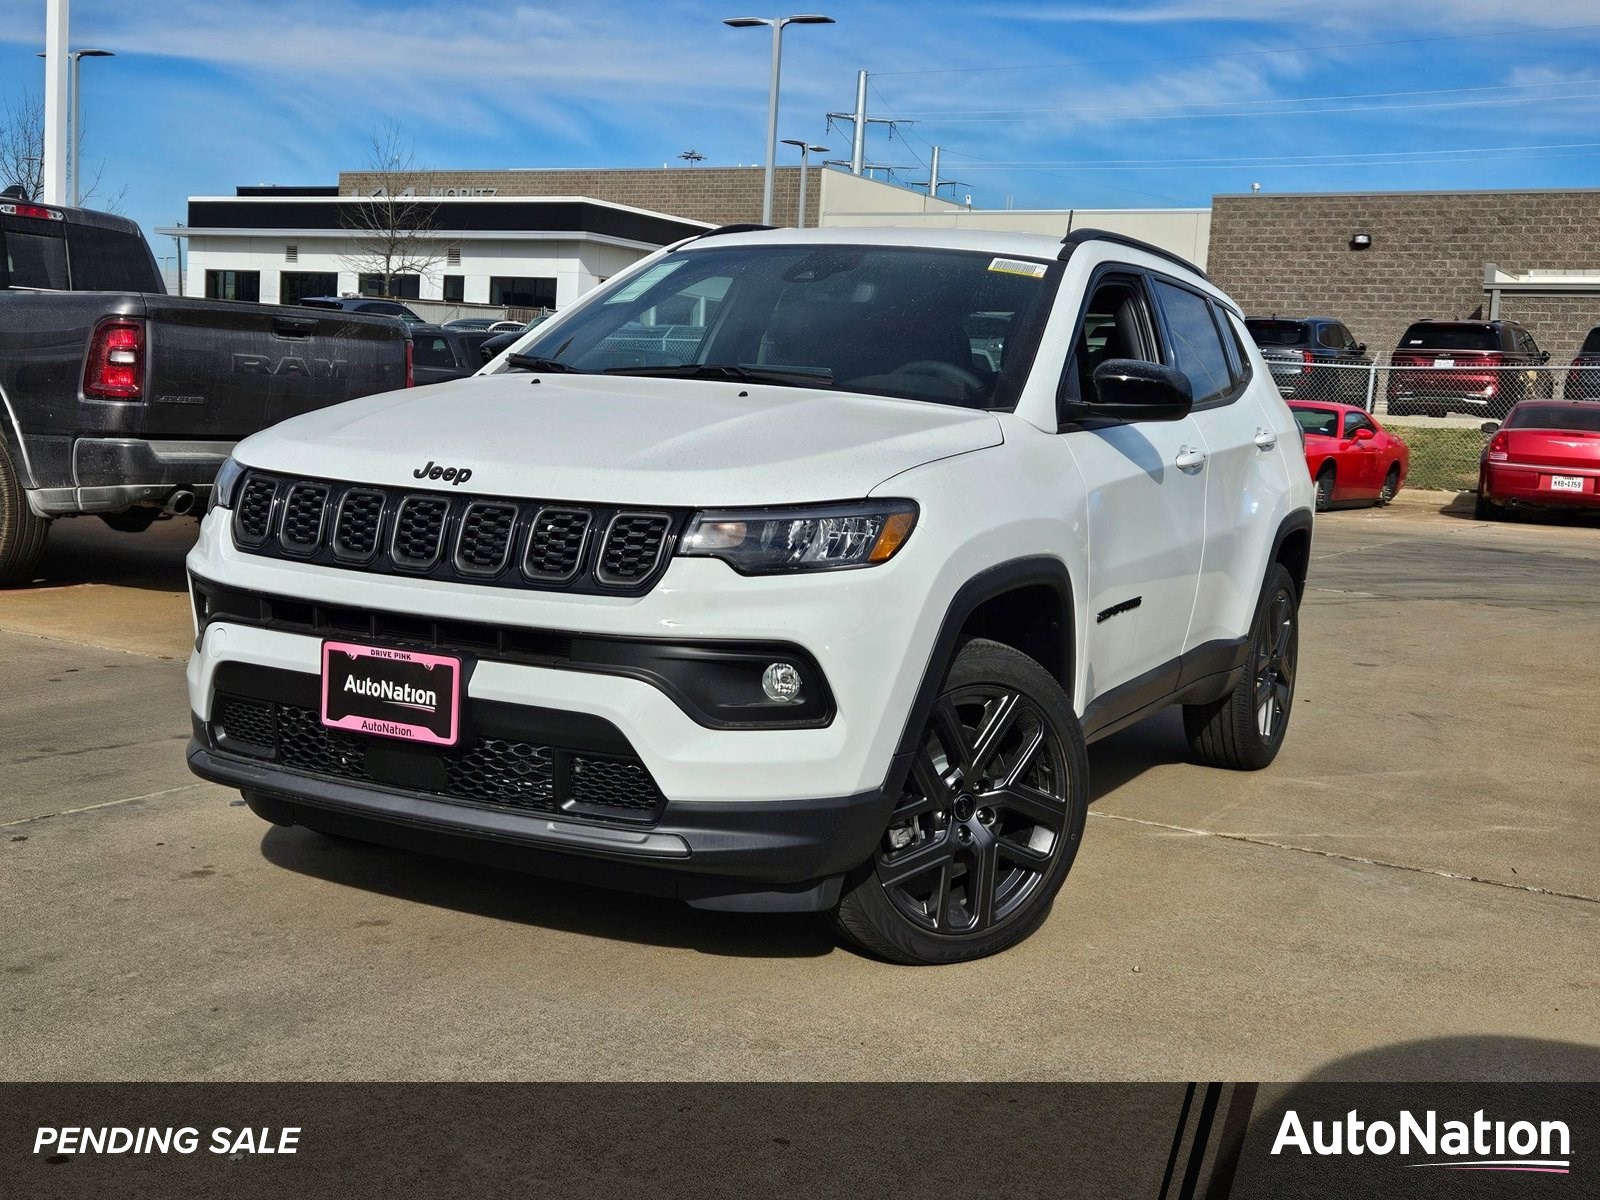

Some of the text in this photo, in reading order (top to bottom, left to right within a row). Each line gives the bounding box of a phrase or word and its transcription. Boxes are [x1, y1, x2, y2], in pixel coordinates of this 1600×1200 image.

[232, 353, 348, 379] RAM
[413, 460, 473, 486] Jeep
[370, 648, 412, 661] DRIVE PINK
[343, 674, 437, 706] AutoNation
[360, 719, 413, 738] AutoNation
